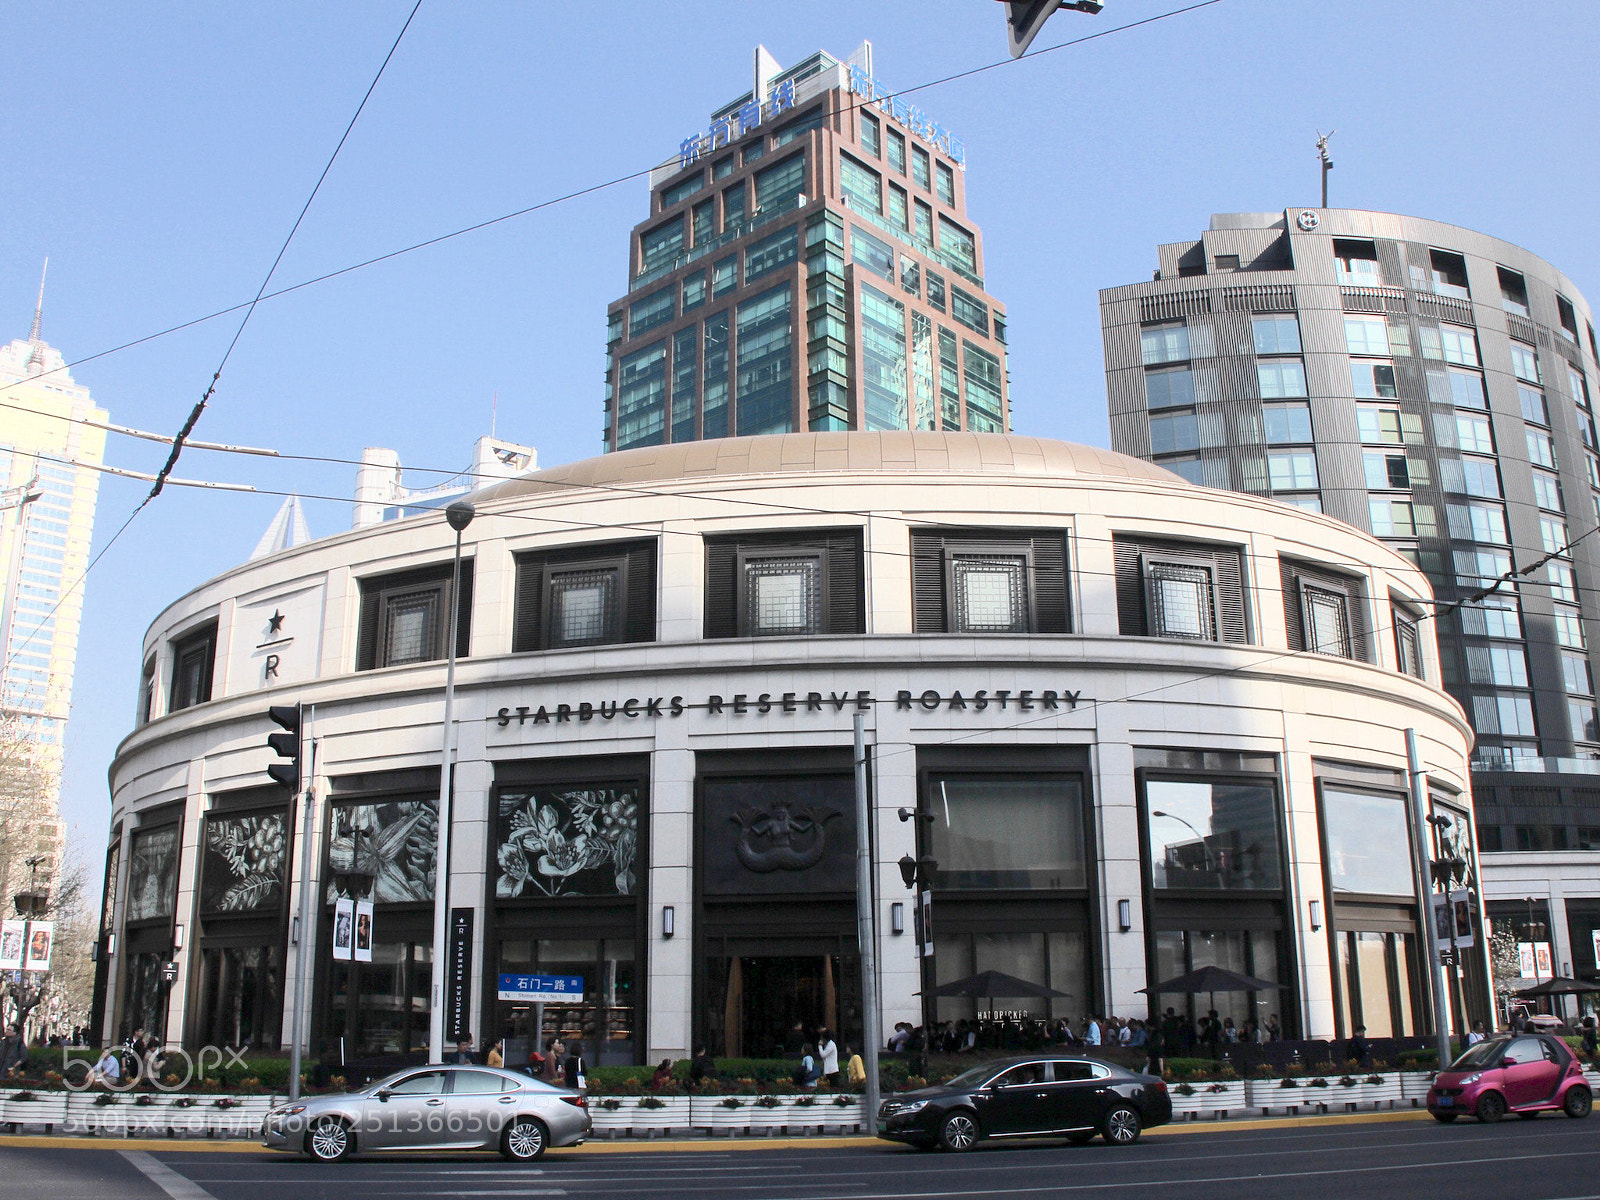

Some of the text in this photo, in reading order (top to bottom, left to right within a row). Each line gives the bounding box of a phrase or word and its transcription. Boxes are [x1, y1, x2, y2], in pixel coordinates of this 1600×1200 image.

[679, 77, 797, 168] 东方有线
[264, 654, 280, 680] R
[497, 689, 1081, 727] STARBUCKS RESERVE ROASTERY
[454, 941, 464, 1035] STARBUCKS RESERVE
[517, 977, 566, 991] 石门一路
